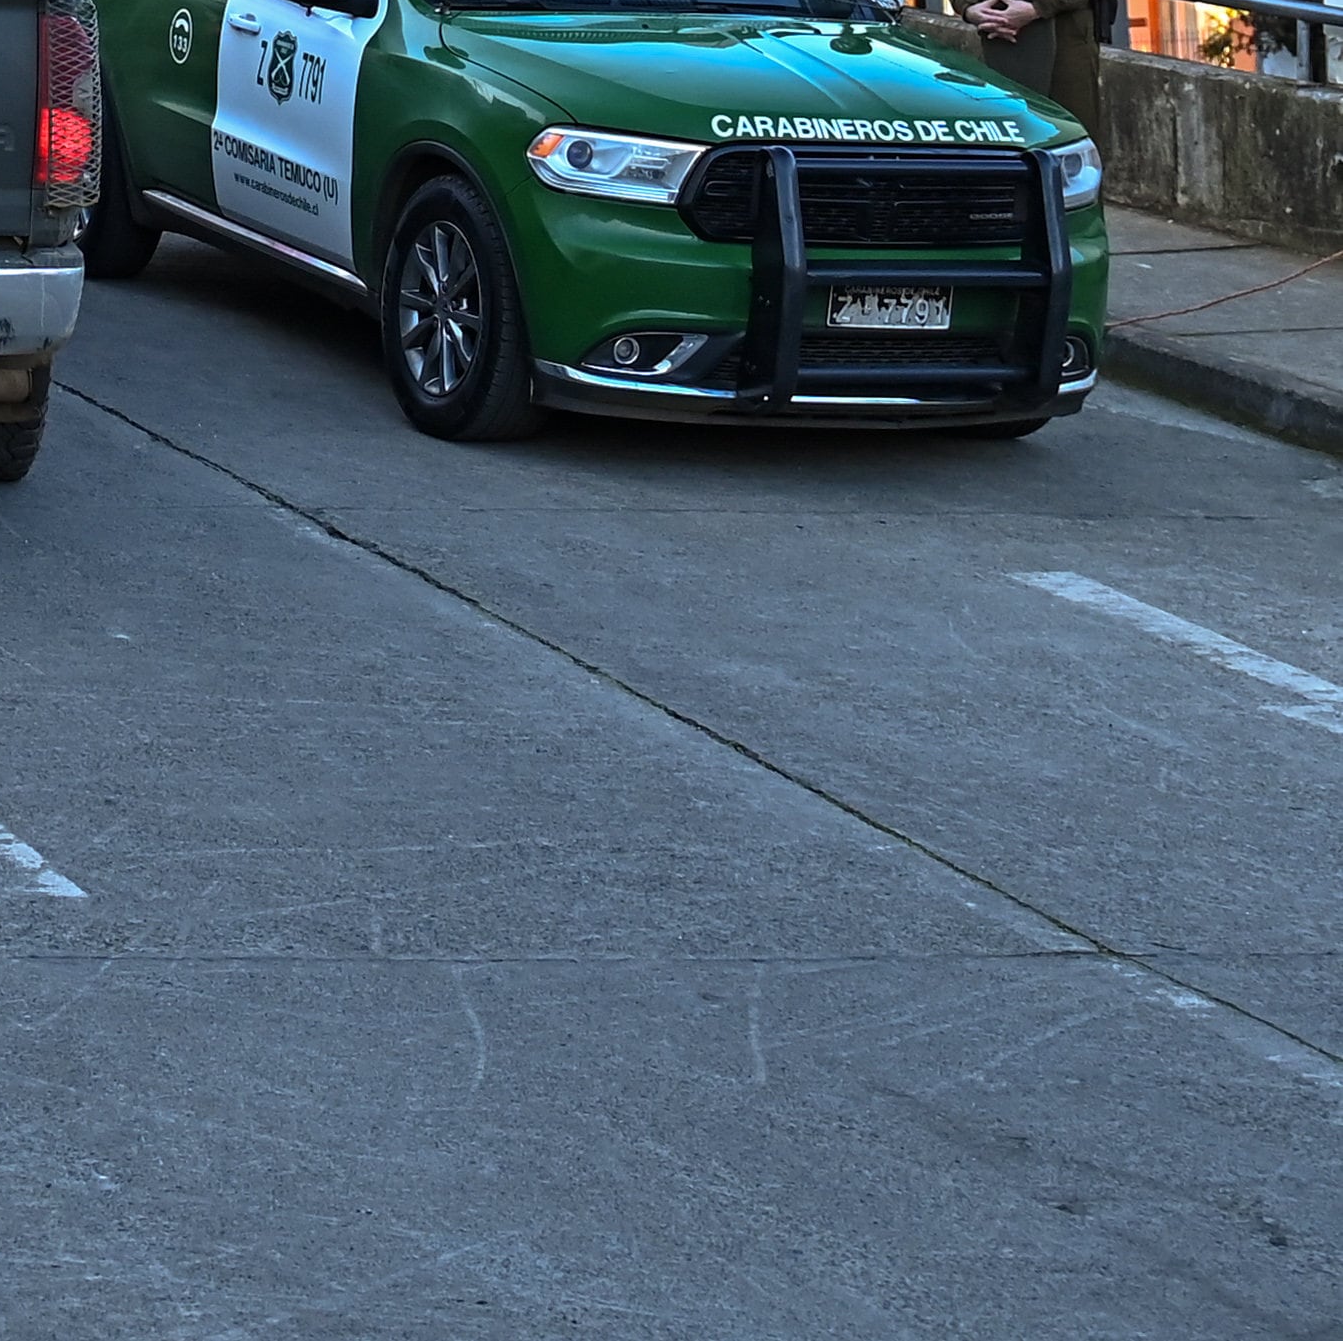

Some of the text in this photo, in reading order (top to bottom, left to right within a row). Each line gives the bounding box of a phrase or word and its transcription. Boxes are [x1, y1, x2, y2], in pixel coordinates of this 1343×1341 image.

[173, 34, 188, 53] 133
[298, 52, 326, 105] 7791
[711, 114, 1025, 143] CARABINEROS DE CHILE
[224, 135, 276, 174] COMISARIA
[277, 157, 321, 194] TEMUCO
[323, 175, 339, 206] (U)
